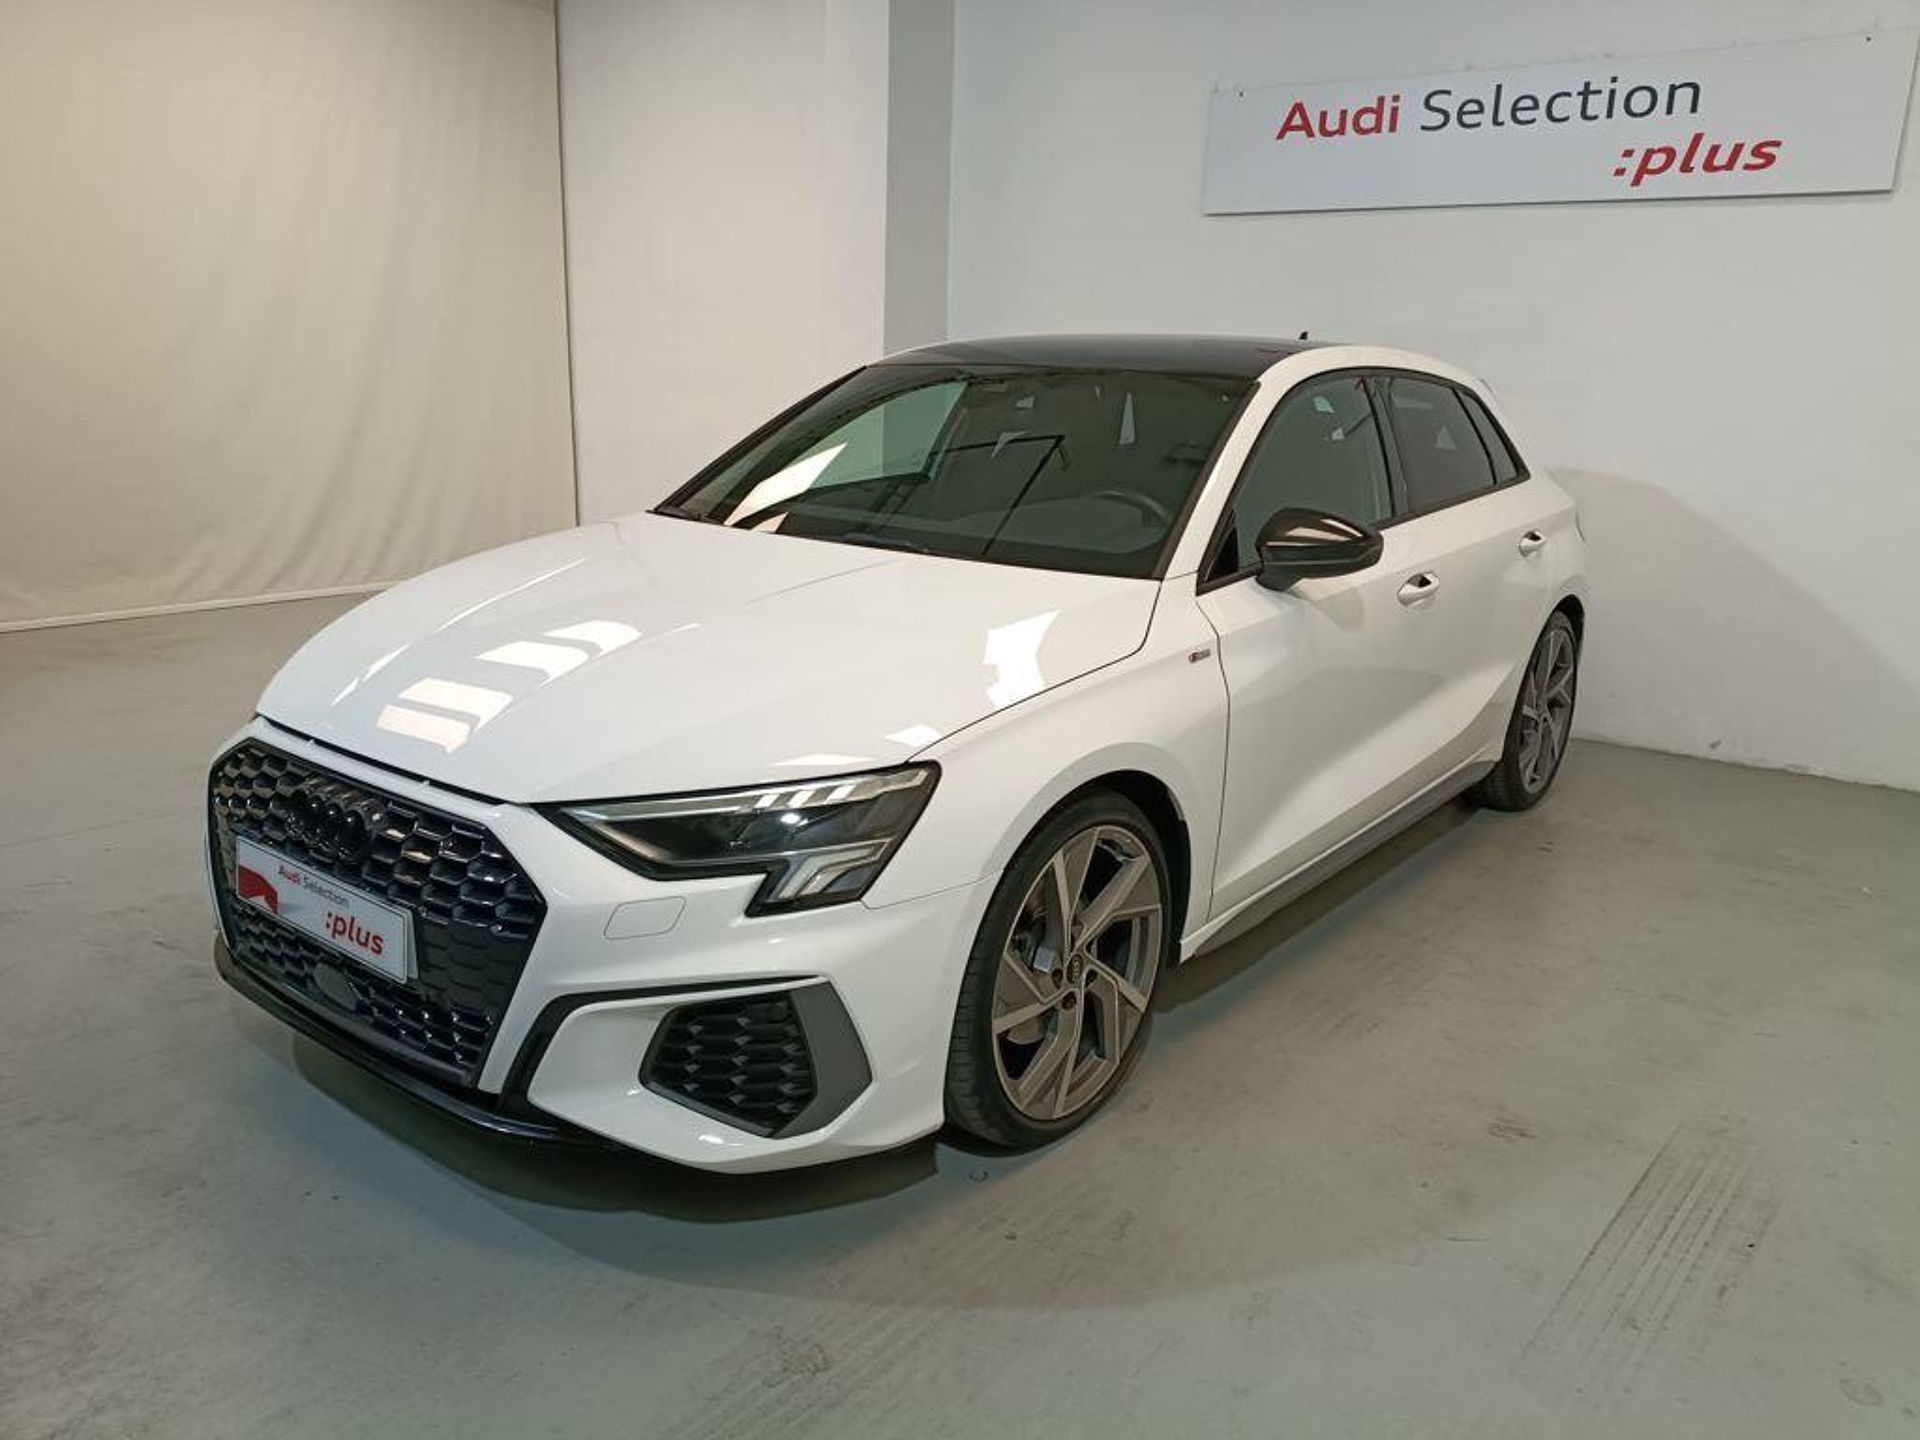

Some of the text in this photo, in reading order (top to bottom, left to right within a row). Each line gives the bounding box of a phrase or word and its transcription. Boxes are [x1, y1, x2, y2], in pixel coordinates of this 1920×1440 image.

[1276, 76, 1701, 140] Audi Selection
[1613, 132, 1782, 187] :plus
[278, 865, 301, 886] Audi
[326, 911, 385, 955] :plus
